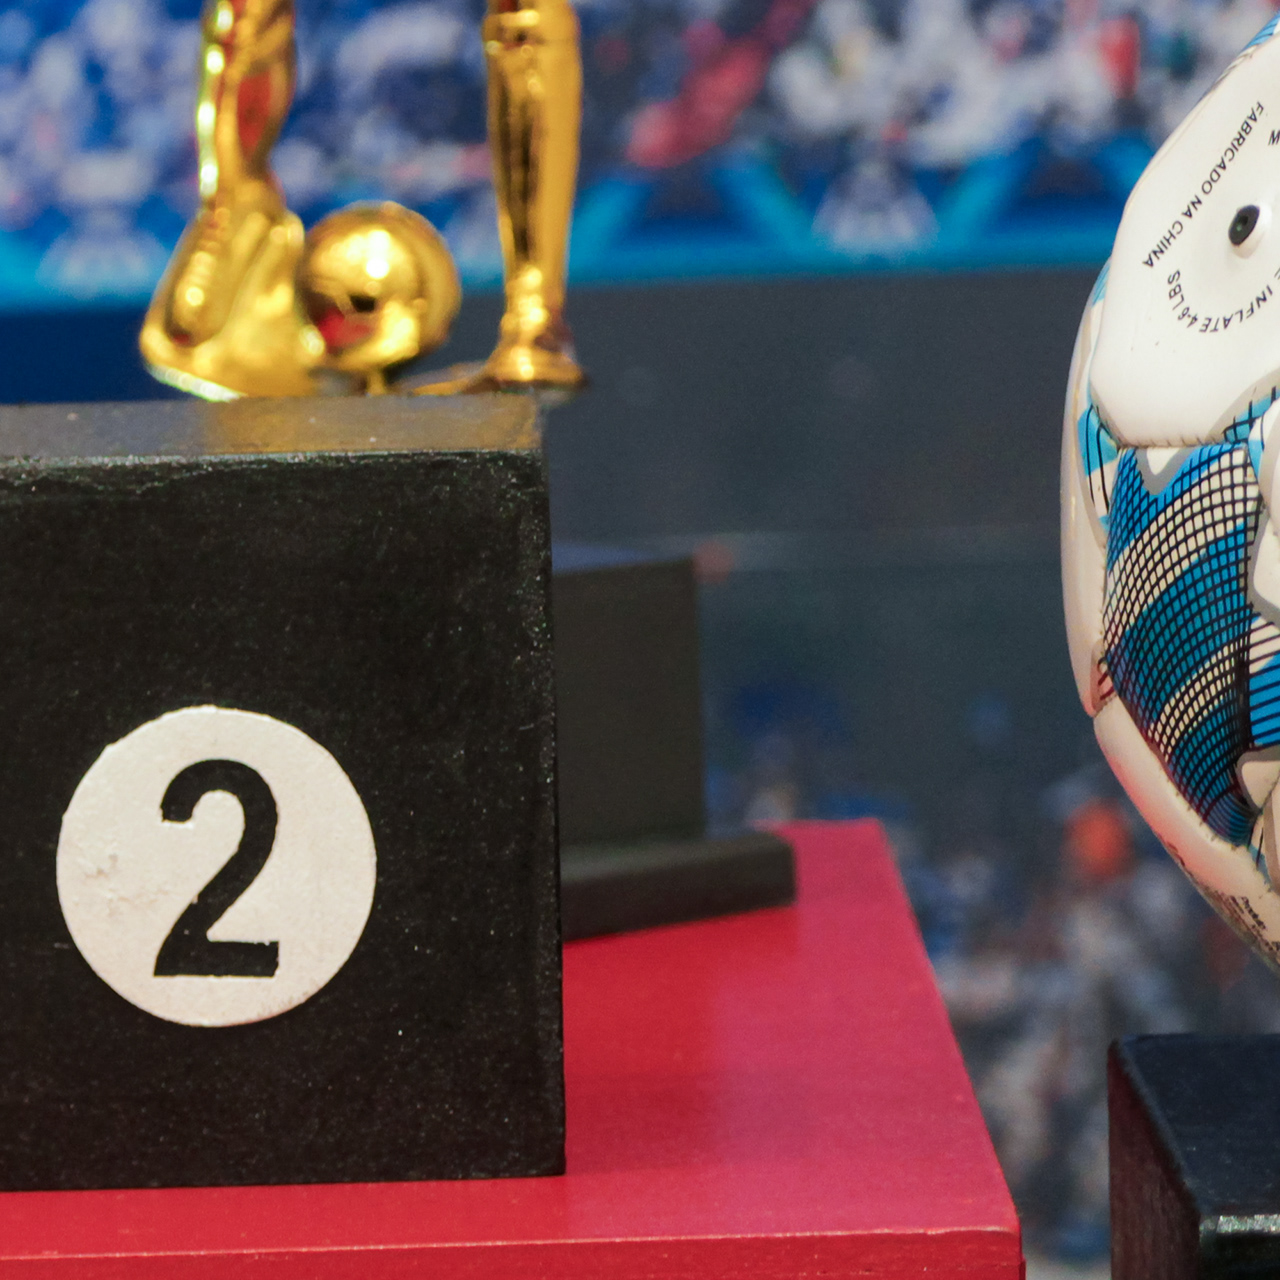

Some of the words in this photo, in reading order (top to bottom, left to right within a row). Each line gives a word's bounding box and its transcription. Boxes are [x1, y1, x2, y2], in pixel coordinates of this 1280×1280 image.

[1201, 101, 1265, 195] FABRICADO
[1181, 195, 1203, 220] NA
[1143, 220, 1184, 269] CHINA
[1198, 284, 1274, 333] INFLATE
[154, 759, 280, 977] 2
